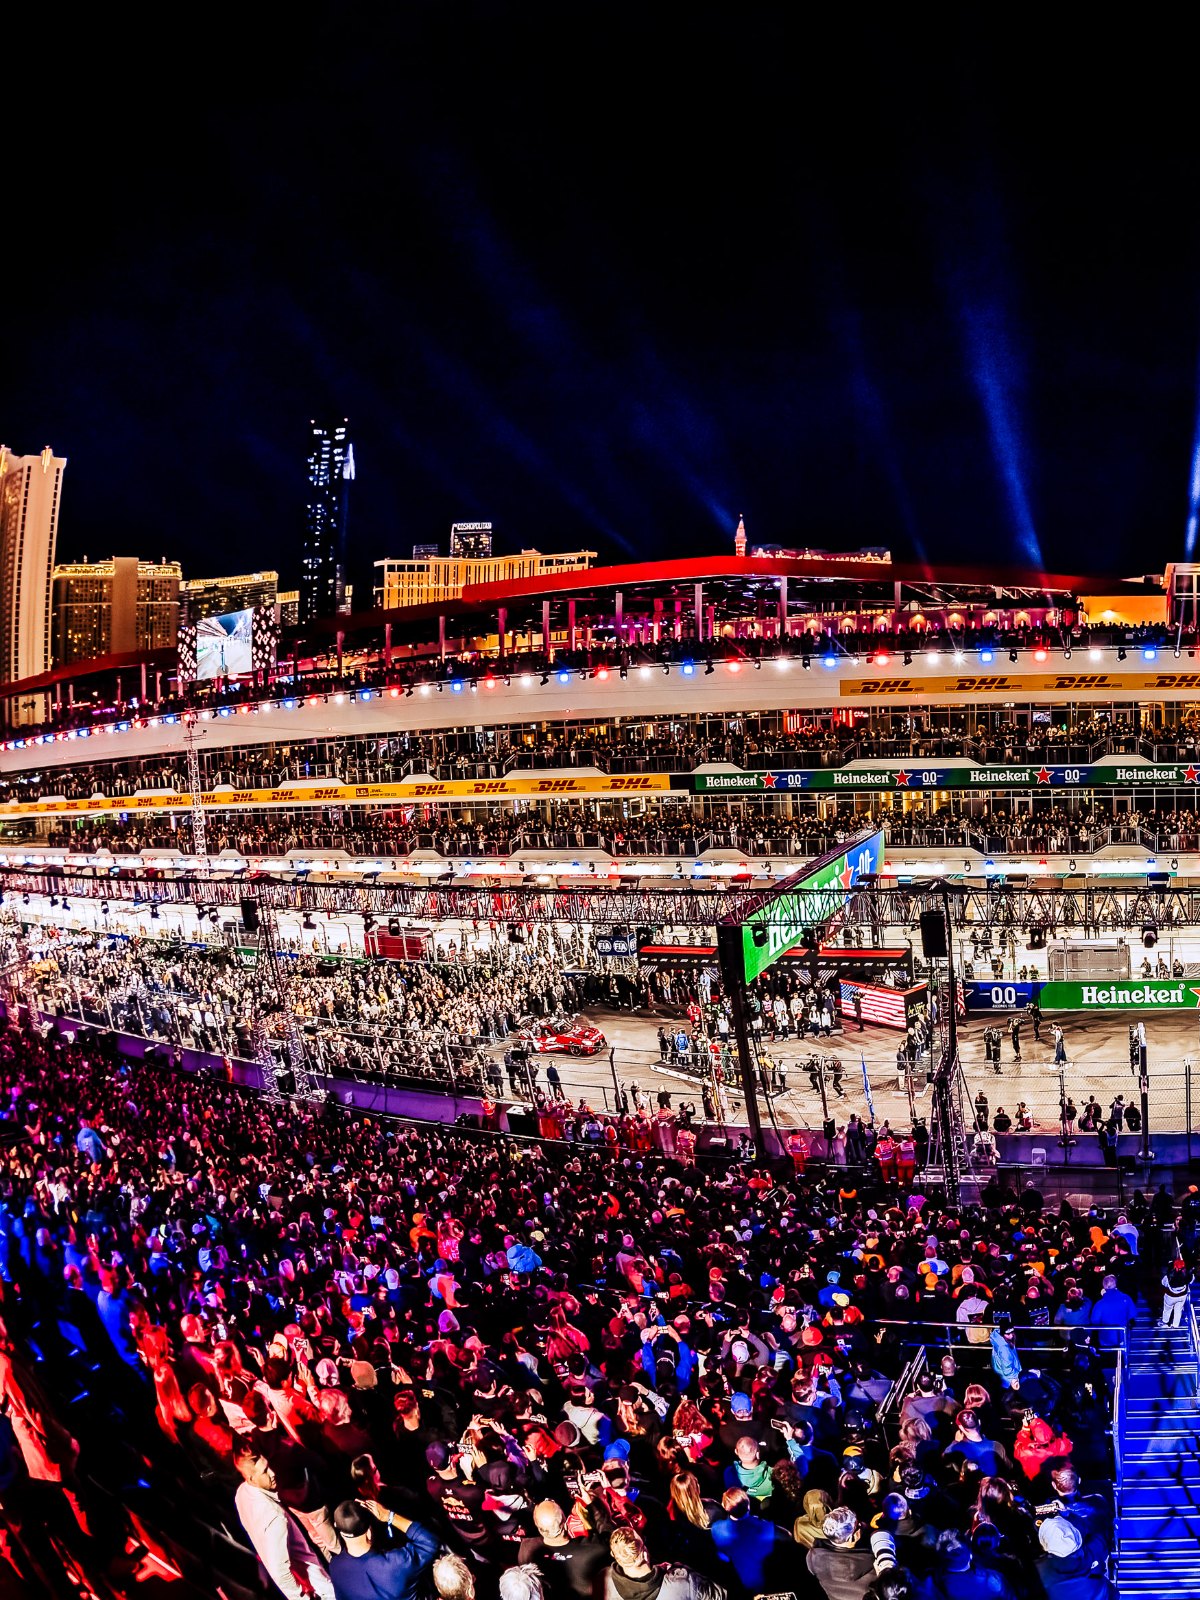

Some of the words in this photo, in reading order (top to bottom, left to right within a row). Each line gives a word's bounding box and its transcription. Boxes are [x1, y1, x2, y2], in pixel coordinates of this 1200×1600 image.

[457, 522, 492, 530] COSMOPOLITAN
[861, 680, 915, 692] DHL
[956, 677, 1011, 690] DHL
[1055, 676, 1111, 688] DHL
[834, 773, 890, 784] Heineken
[970, 770, 1029, 782] Heineken
[1116, 768, 1177, 780] Heineken
[474, 782, 509, 792] DHL
[538, 780, 578, 792] DHL
[610, 778, 652, 790] DHL
[706, 775, 757, 787] Heineken
[272, 791, 294, 800] DHL
[314, 789, 340, 798] DHL
[415, 784, 447, 796] DHL
[138, 798, 152, 806] DHL
[232, 793, 252, 802] DHL
[992, 987, 1016, 1004] 0.0
[1082, 986, 1184, 1004] Heineken
